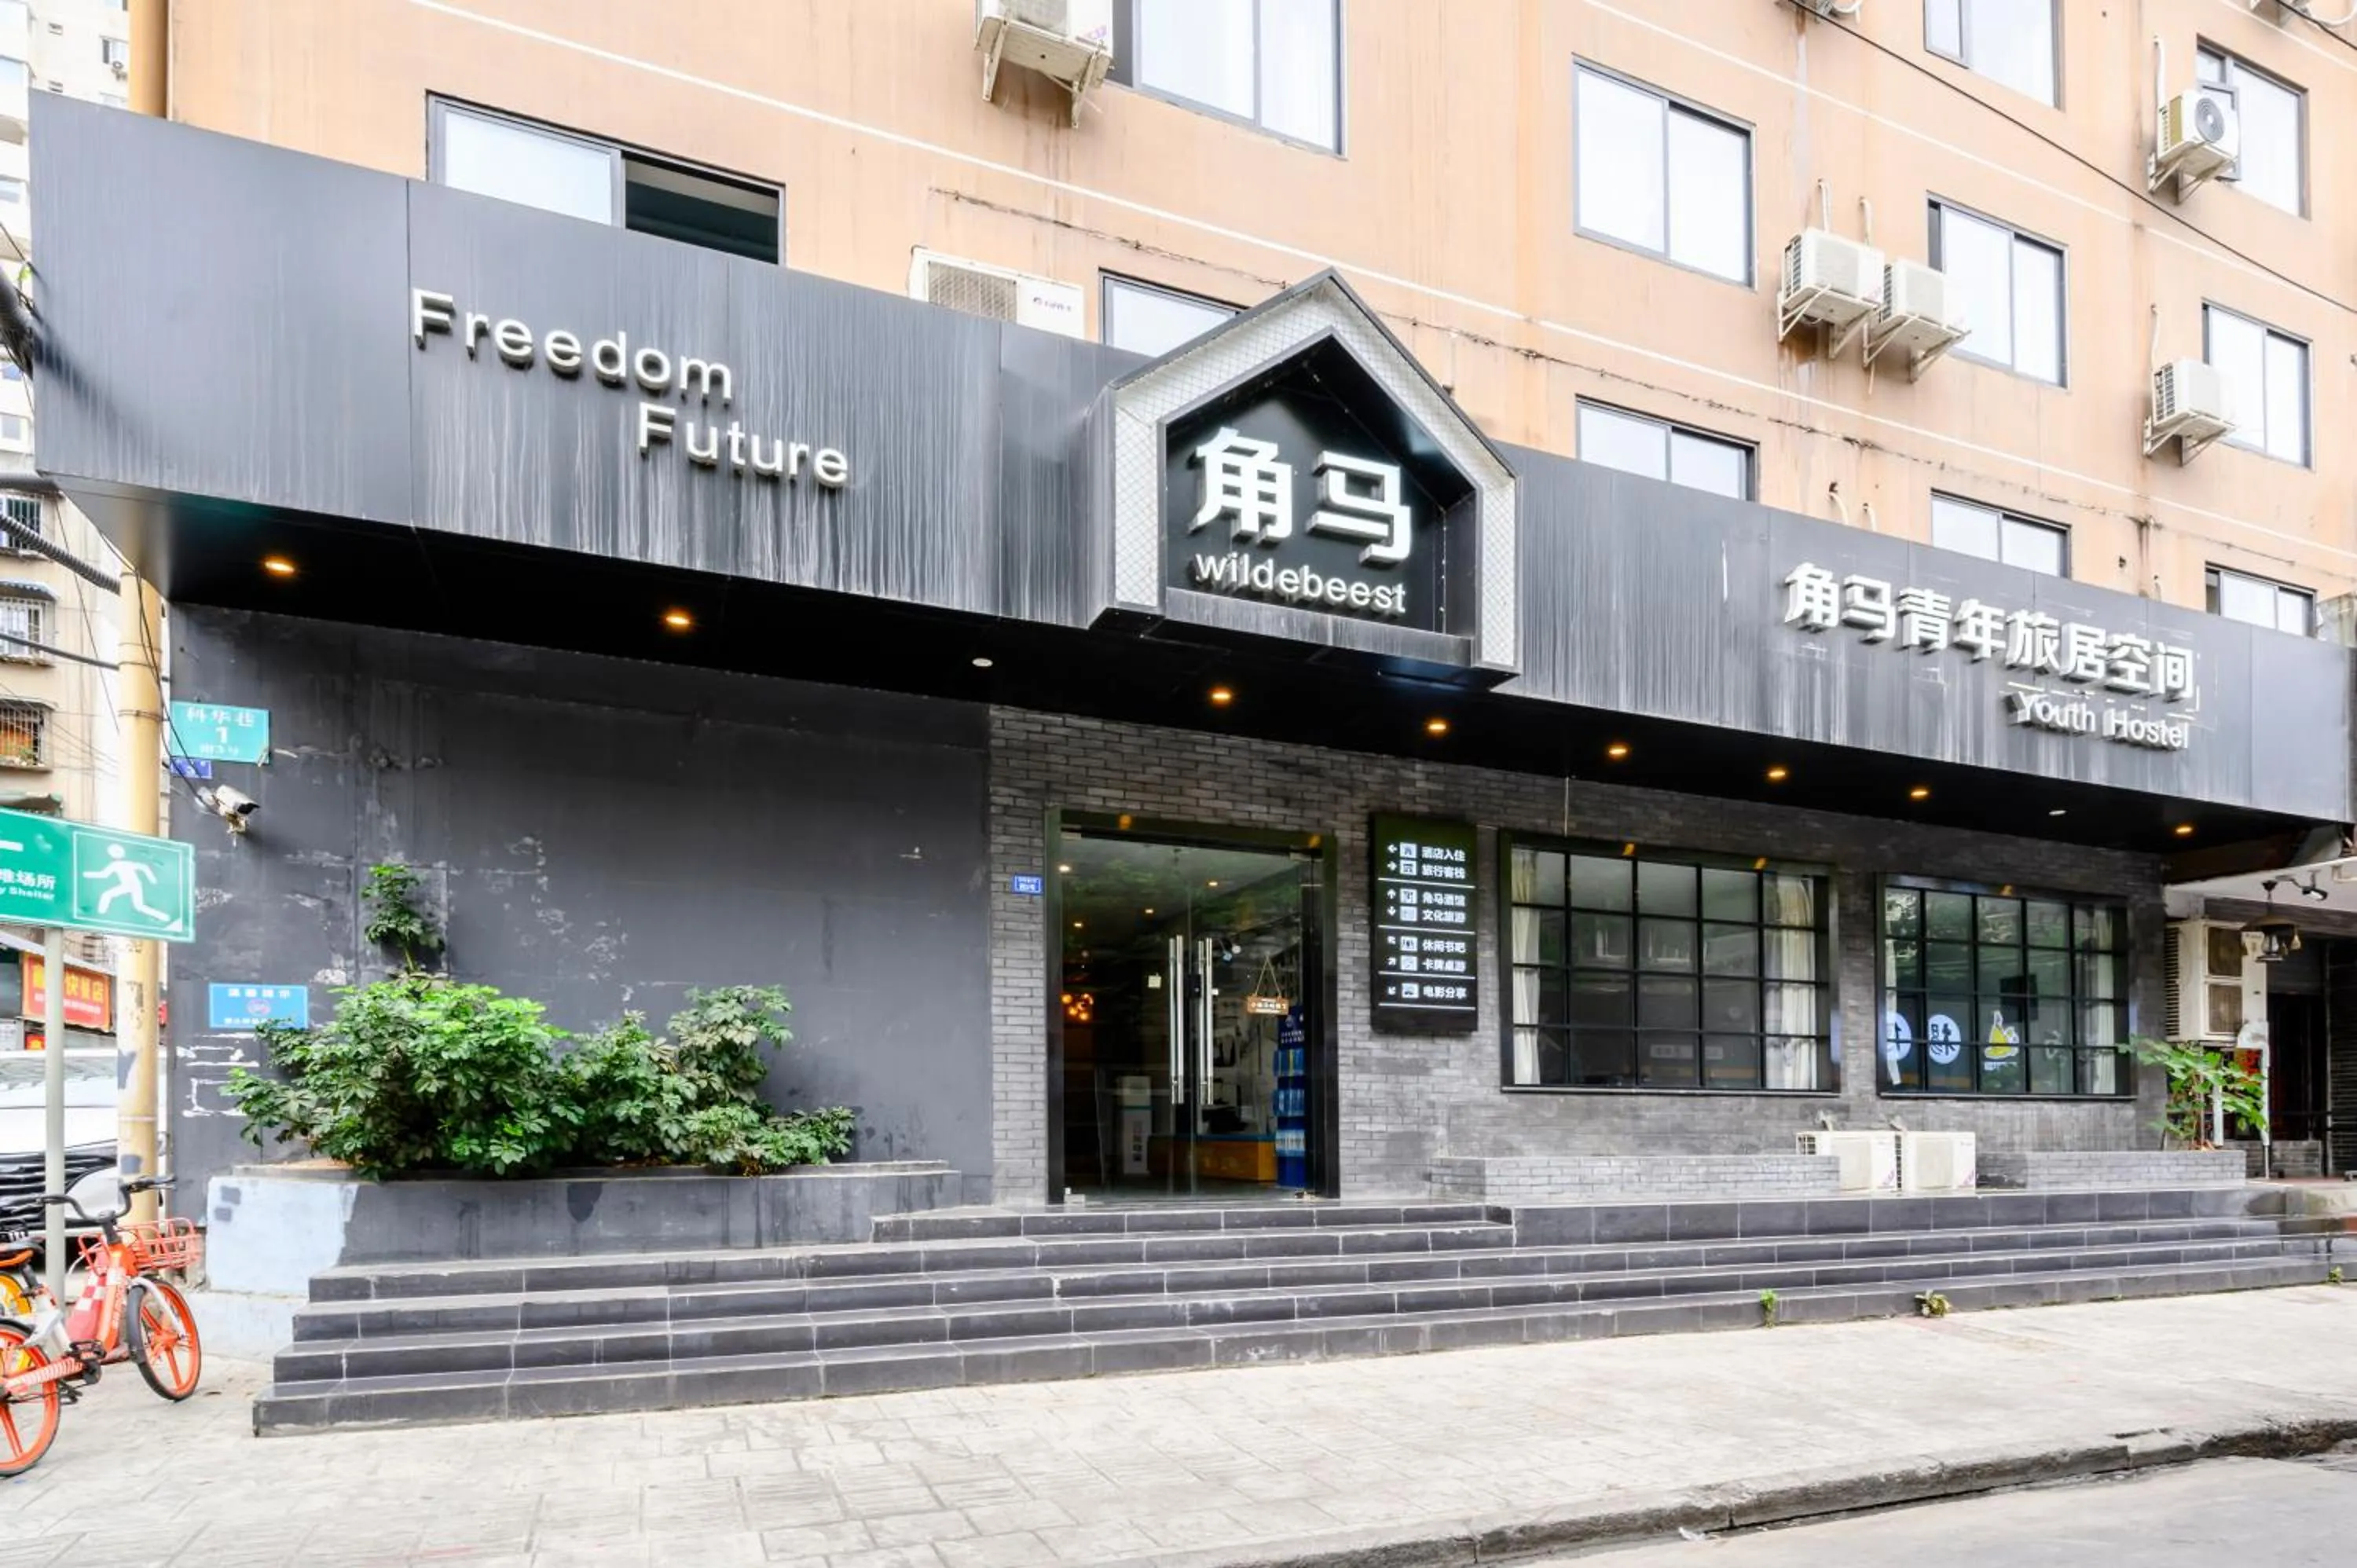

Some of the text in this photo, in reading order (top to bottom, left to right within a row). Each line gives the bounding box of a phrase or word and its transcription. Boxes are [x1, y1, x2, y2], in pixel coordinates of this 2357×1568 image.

[412, 288, 731, 401] Freedom
[637, 401, 849, 489] Future
[1188, 427, 1412, 562] 角马
[1193, 551, 1406, 614] wildebeest
[1783, 562, 2194, 699] 角马青年旅居空间
[2014, 690, 2190, 749] Youth Hostel
